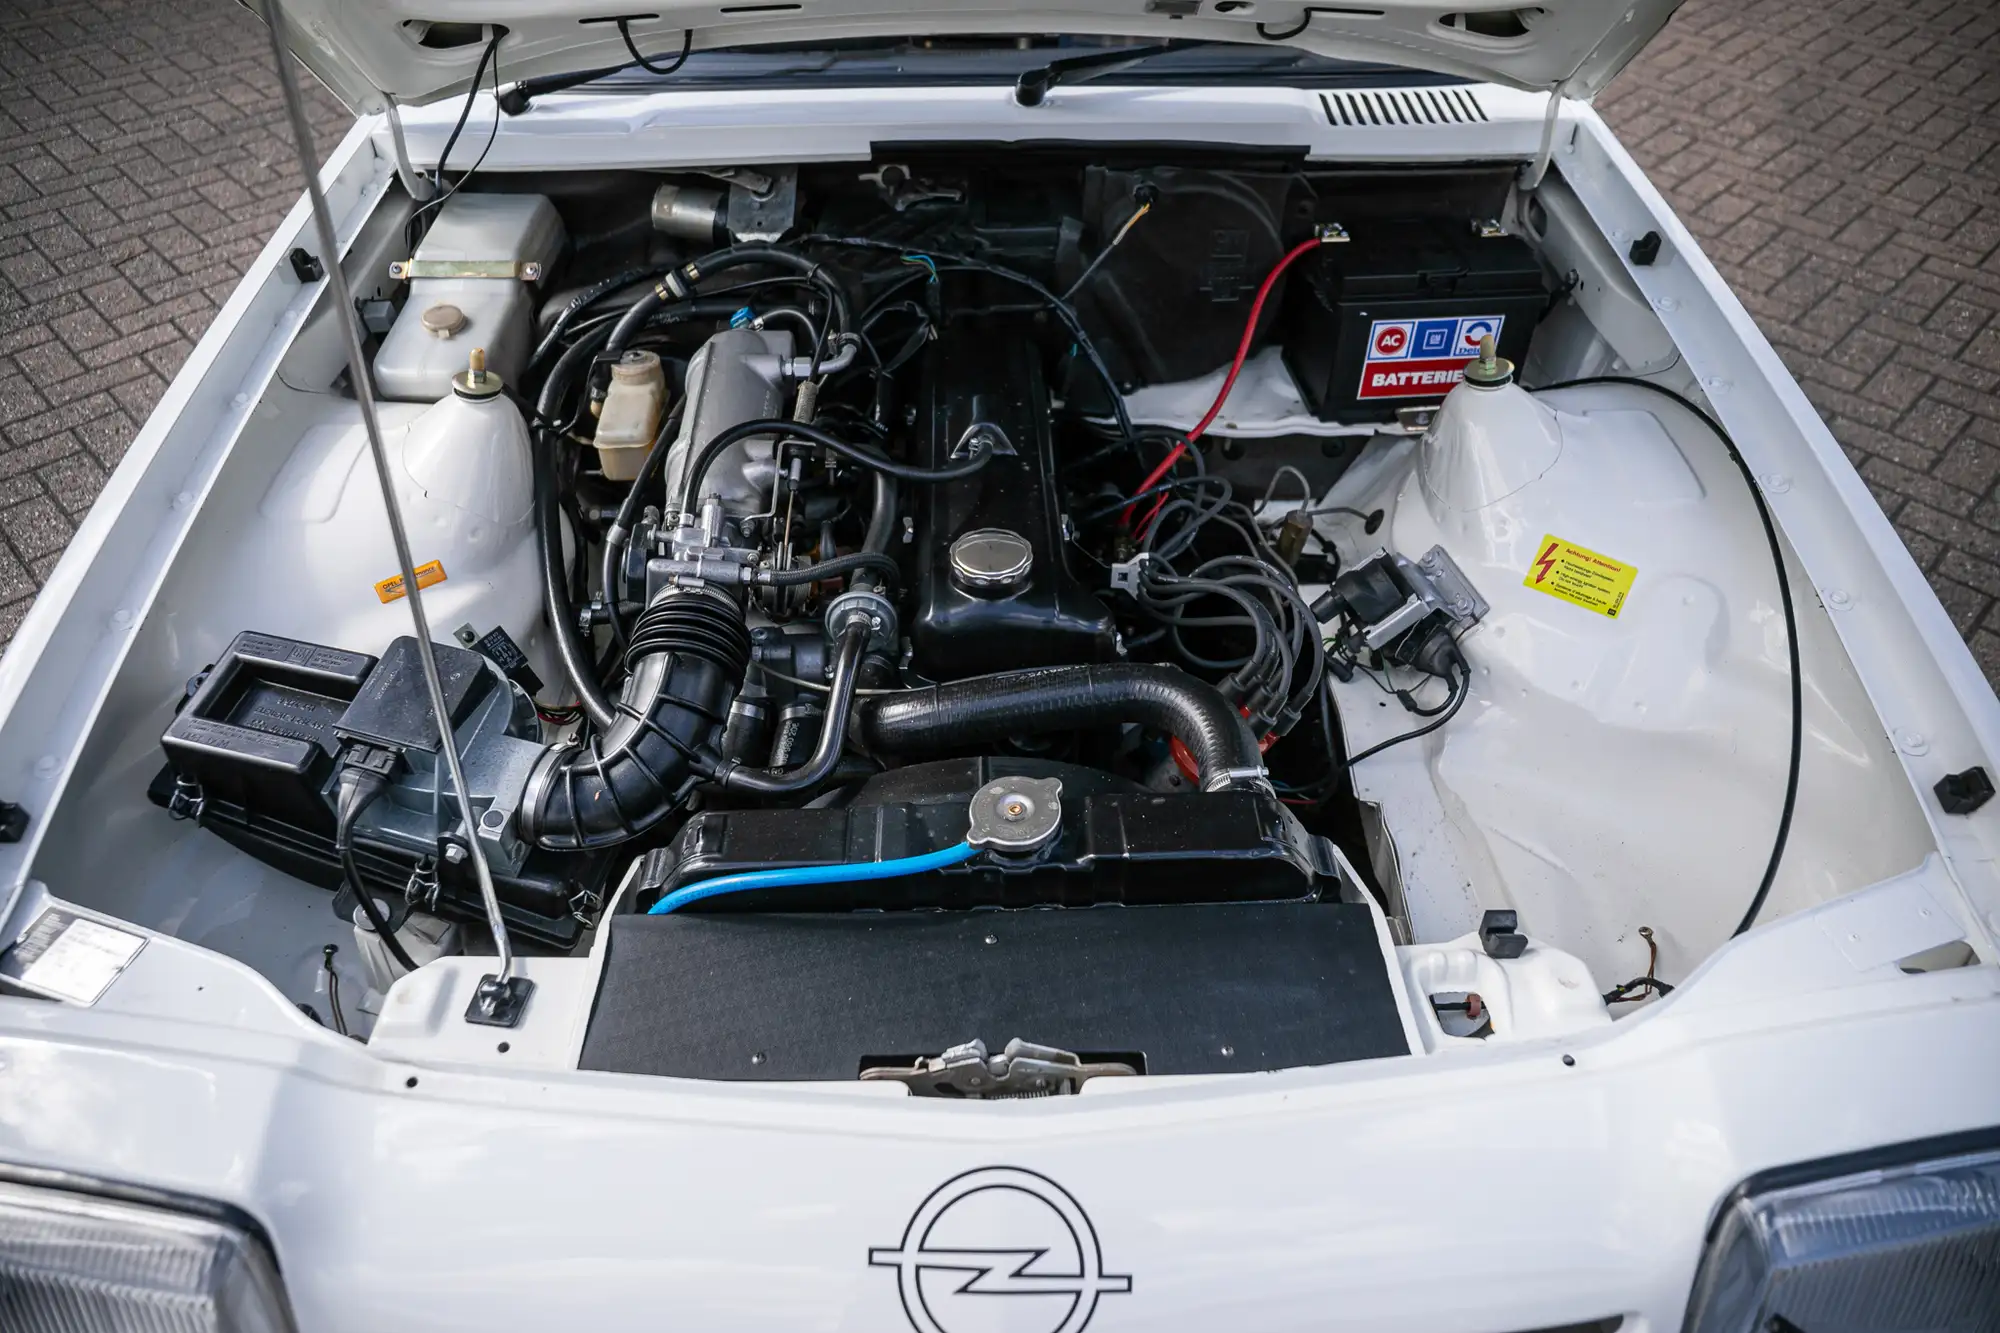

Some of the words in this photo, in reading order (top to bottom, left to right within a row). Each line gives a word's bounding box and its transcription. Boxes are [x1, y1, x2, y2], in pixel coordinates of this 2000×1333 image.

[1381, 334, 1401, 347] AC
[1372, 370, 1464, 386] BATTERIE
[1566, 548, 1591, 562] Achtung!
[1592, 558, 1621, 573] Attention!
